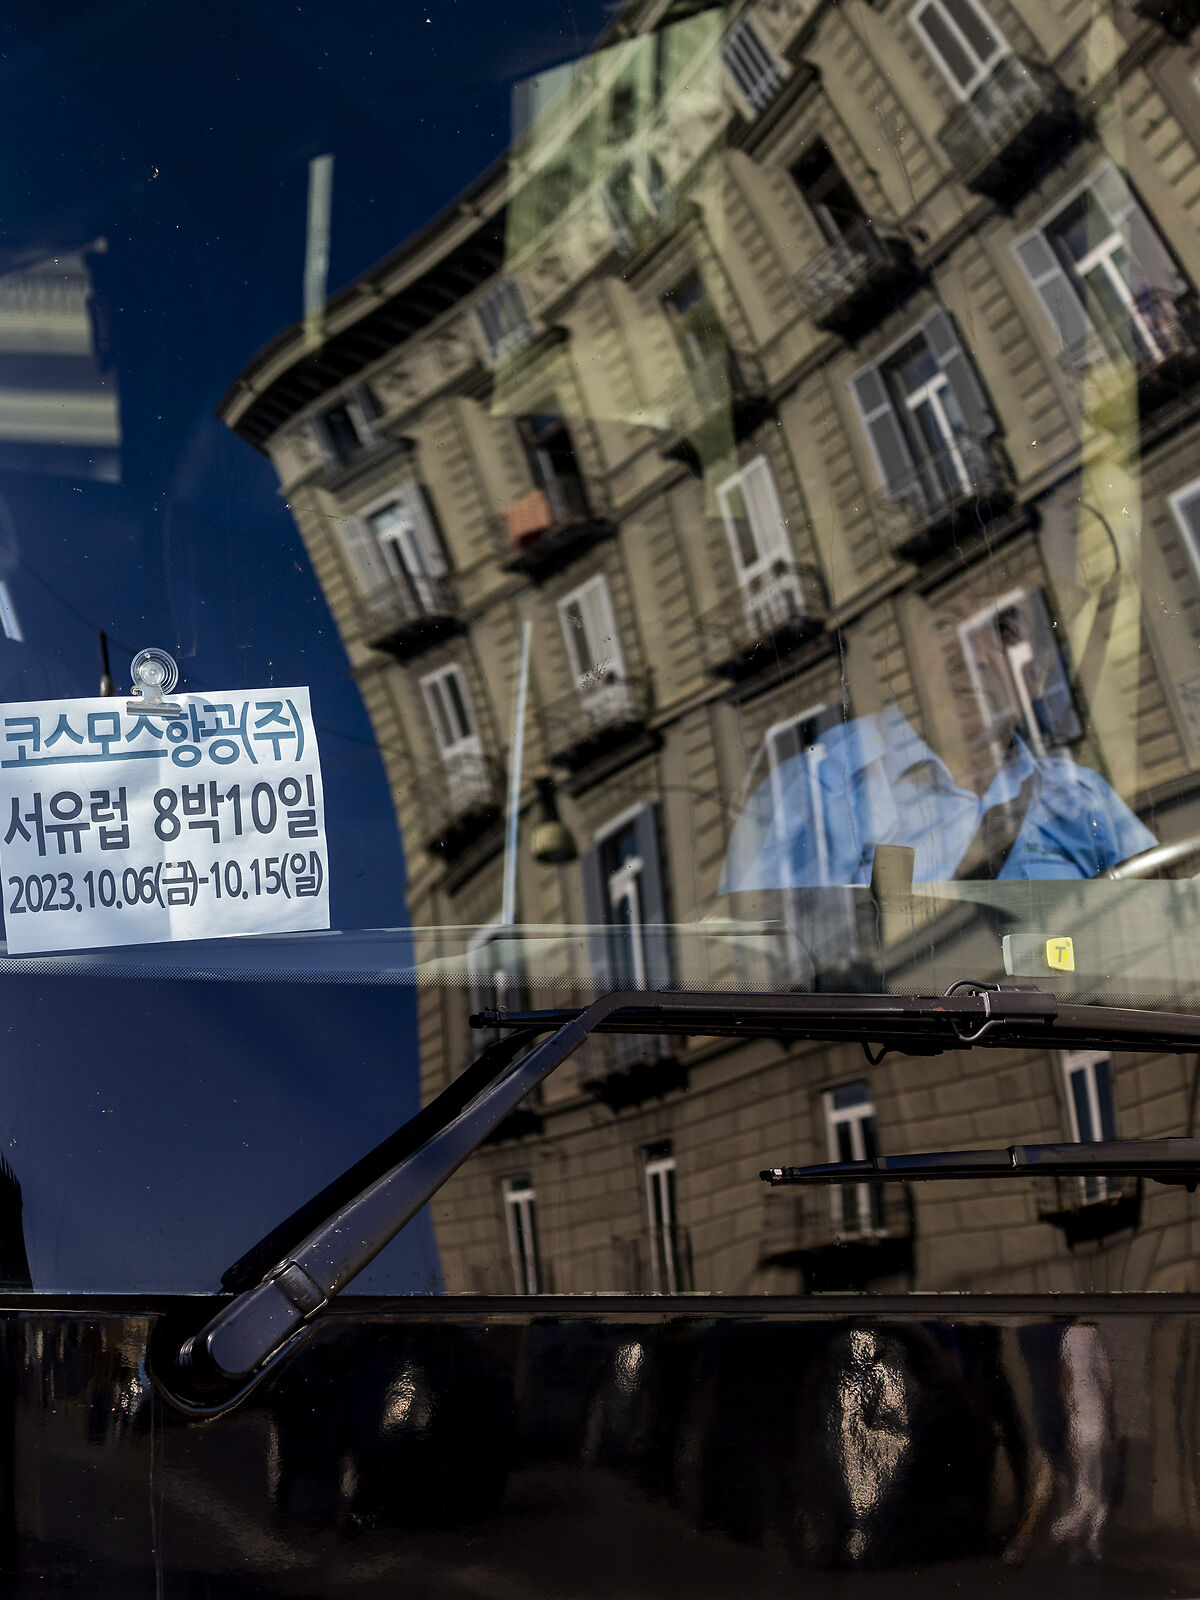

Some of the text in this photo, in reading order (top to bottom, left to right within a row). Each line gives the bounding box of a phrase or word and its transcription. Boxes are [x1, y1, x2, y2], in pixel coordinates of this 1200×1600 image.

[1, 699, 305, 769] 코스모스항공(주)
[3, 774, 319, 857] 서유럽 8박10일
[8, 851, 323, 914] 2023.10.06(금)-10.15(일)
[1055, 946, 1067, 963] T
